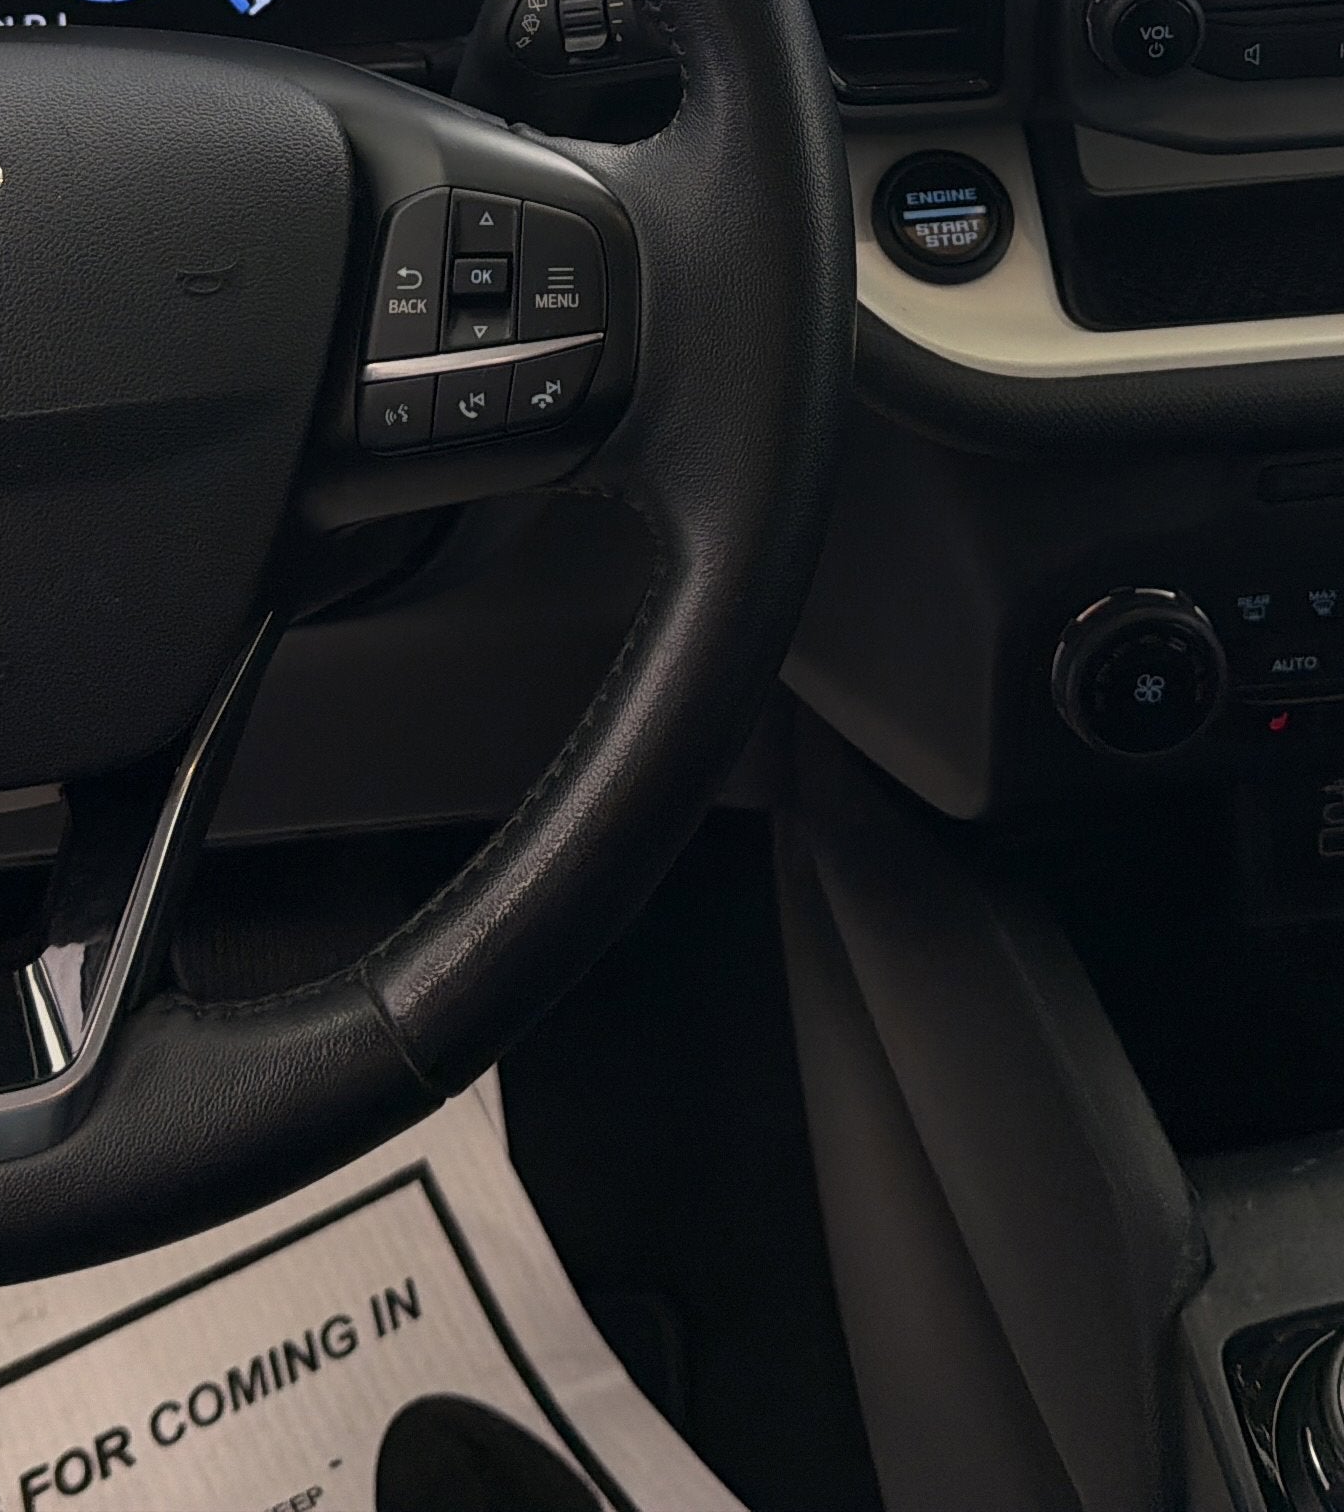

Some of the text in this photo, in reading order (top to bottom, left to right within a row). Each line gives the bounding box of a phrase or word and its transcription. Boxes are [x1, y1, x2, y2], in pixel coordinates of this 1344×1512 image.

[1140, 26, 1173, 40] VOL
[906, 188, 978, 205] ENGINE
[915, 219, 981, 237] START
[926, 232, 978, 248] STOP
[471, 270, 492, 284] OK
[388, 299, 427, 314] BACK
[535, 294, 579, 309] MENU
[1237, 594, 1270, 607] REAR
[1309, 590, 1337, 602] MAX
[1272, 656, 1317, 672] AUTO
[19, 1277, 422, 1512] FOR COMING IN
